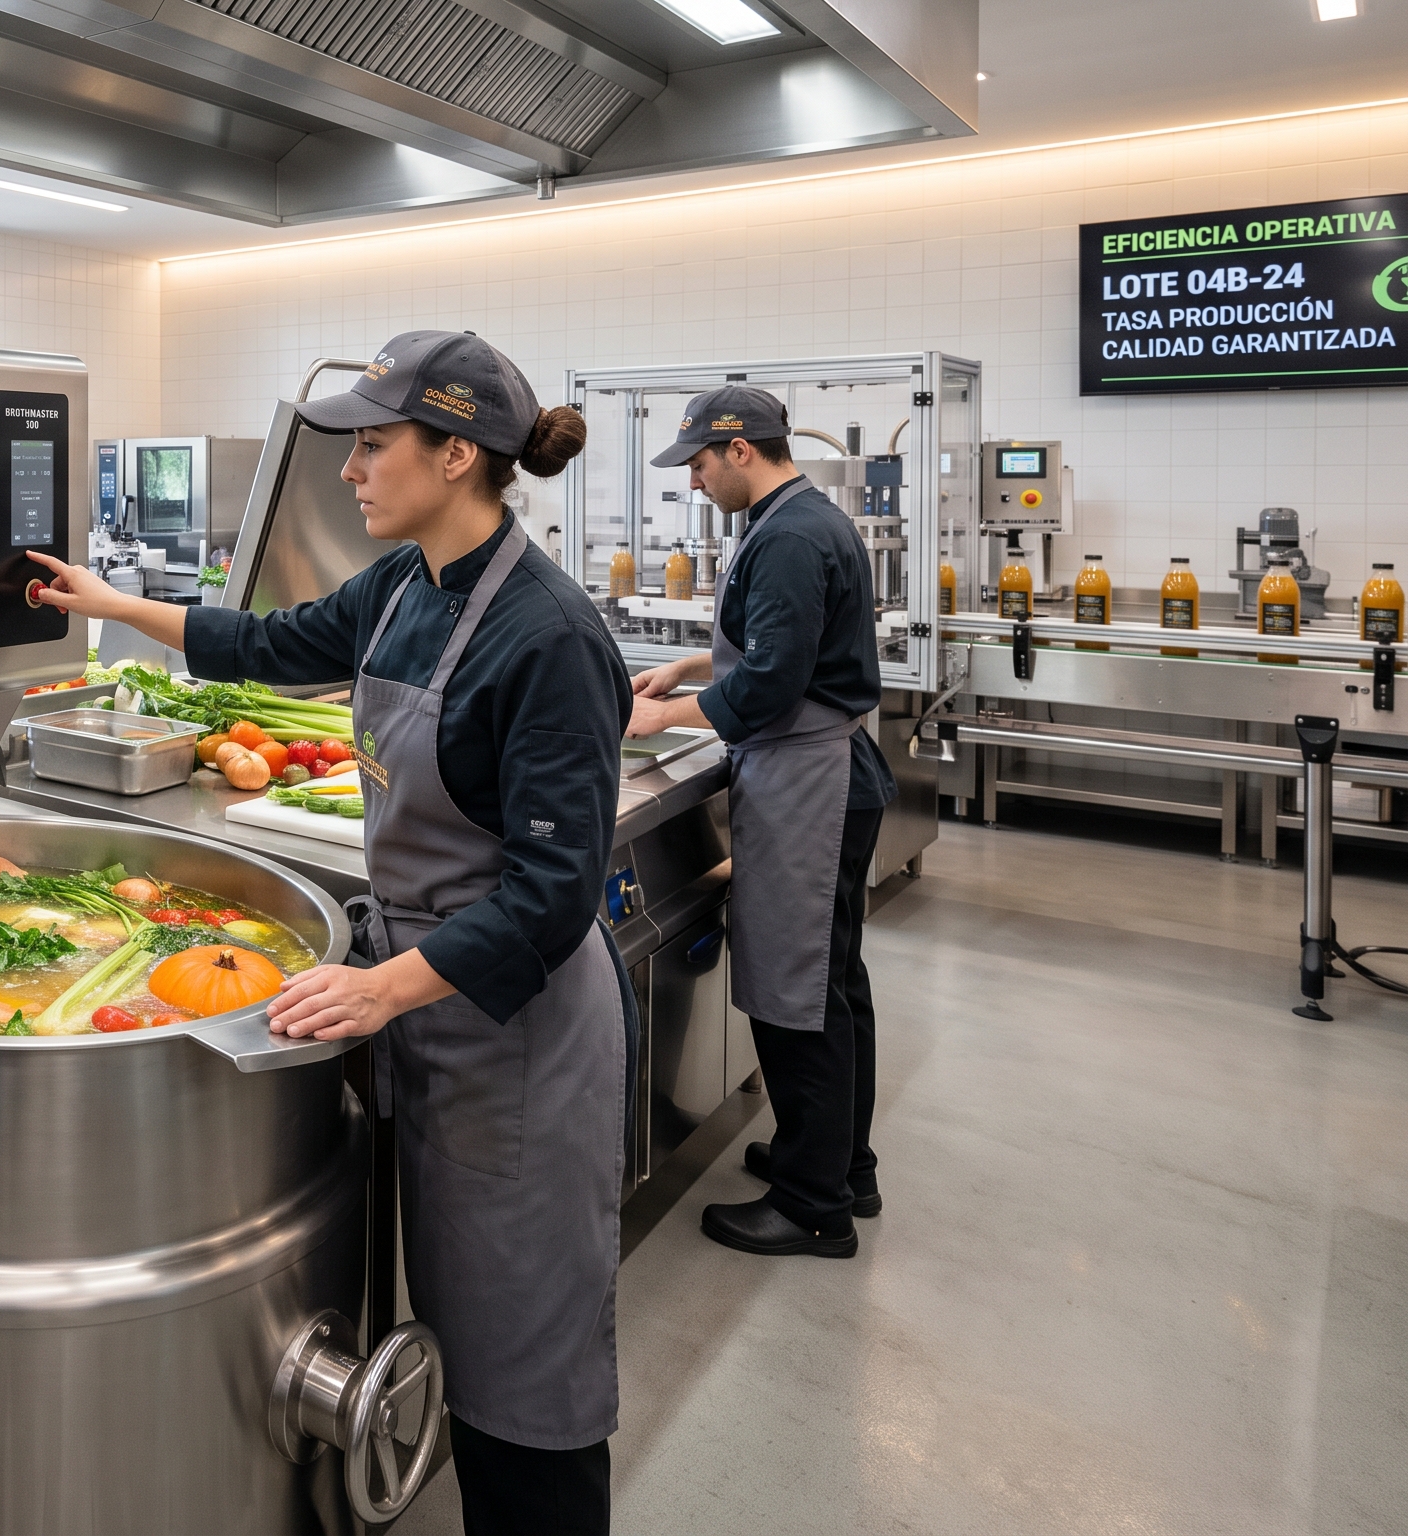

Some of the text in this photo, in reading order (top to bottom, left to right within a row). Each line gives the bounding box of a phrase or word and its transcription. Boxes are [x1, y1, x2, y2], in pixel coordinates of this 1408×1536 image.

[1103, 210, 1396, 255] EFICIENCIA OPERATIVA
[1103, 262, 1305, 300] LOTE 04B-24
[1102, 296, 1333, 332] TASA PRODUCCIÓN
[1102, 326, 1396, 360] CALIDAD GARANTIZADA
